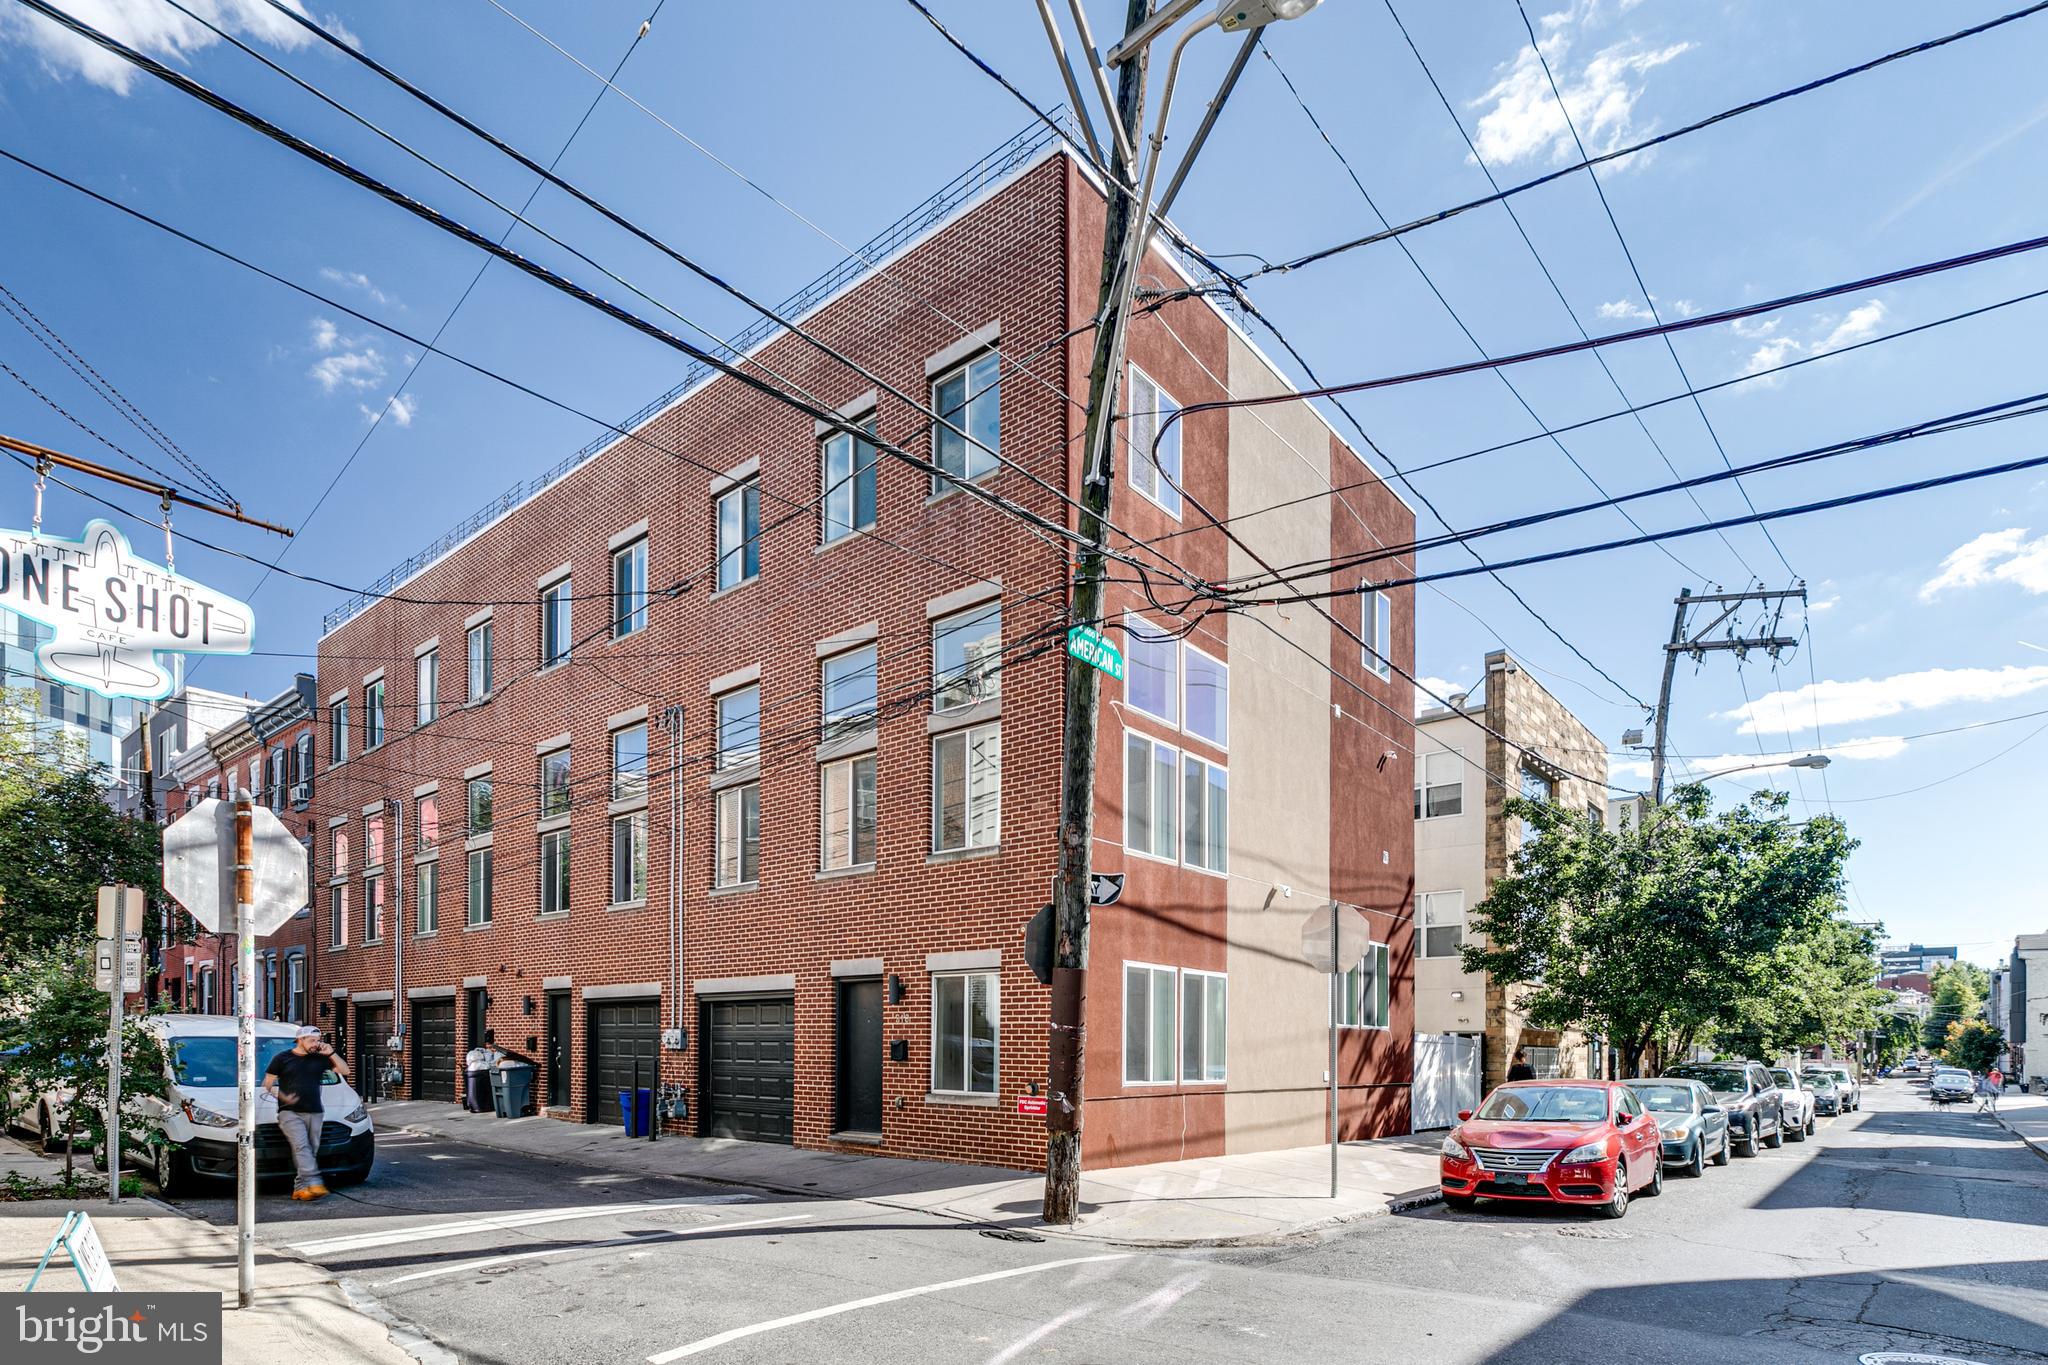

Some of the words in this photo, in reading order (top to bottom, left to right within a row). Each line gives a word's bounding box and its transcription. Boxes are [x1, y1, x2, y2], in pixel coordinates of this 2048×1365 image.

[105, 577, 214, 645] SHOT
[86, 629, 128, 645] CAFE
[1070, 634, 1114, 673] AMERICAN
[1115, 663, 1122, 677] ST
